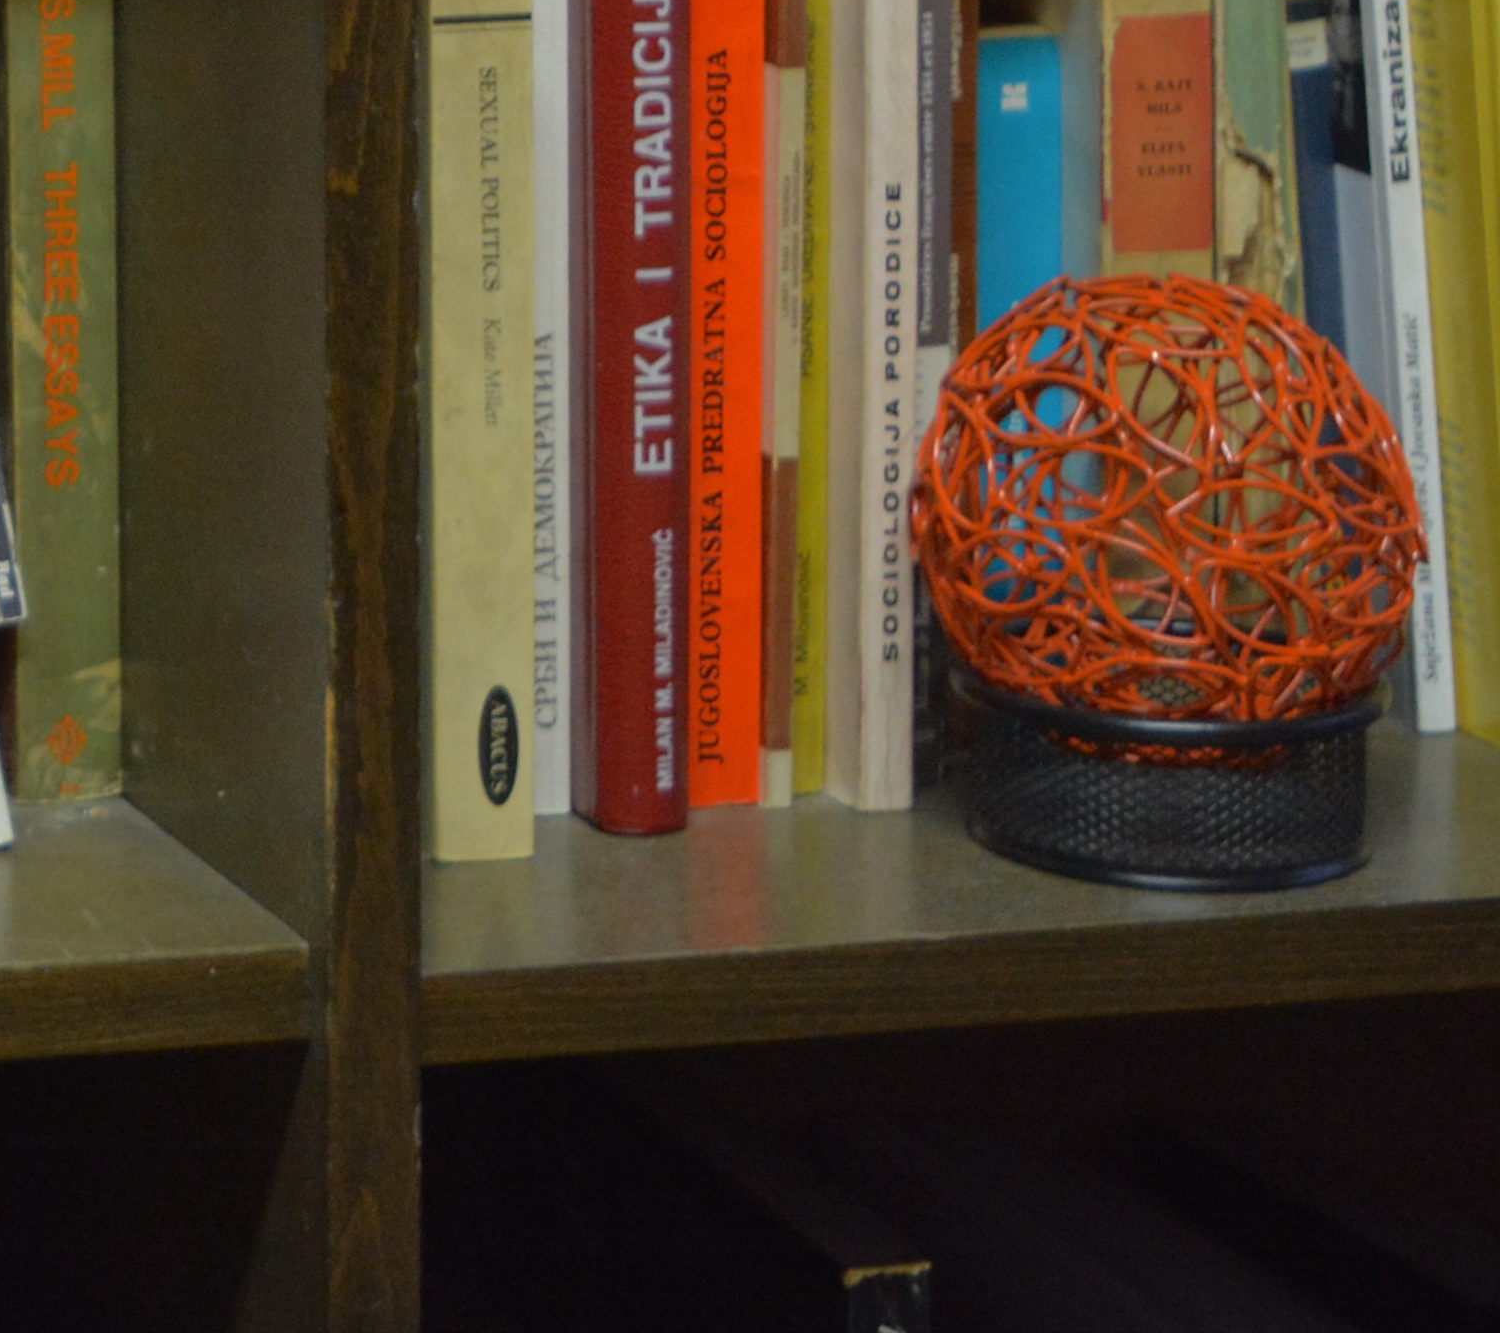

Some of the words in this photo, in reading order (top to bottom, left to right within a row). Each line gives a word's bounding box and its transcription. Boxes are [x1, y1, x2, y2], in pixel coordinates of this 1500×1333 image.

[43, 161, 78, 305] THREE
[704, 48, 731, 263] SOCIOLOGIJA
[632, 264, 674, 282] I
[883, 181, 902, 382] PORODICE
[43, 314, 78, 489] ESSAYS
[532, 331, 561, 583] ДЕМОКРАТИЈА
[632, 313, 674, 477] ETIKA
[700, 278, 726, 475] PREDRATNA
[533, 598, 557, 624] И
[651, 526, 674, 674] MILADINOVIĆ
[882, 397, 903, 663] SOCIOLOGIJA
[532, 638, 558, 730] СРБИ
[697, 488, 724, 766] JUGOSLOVENSKA
[489, 697, 509, 796] ABACUS
[655, 716, 675, 790] MILAN
